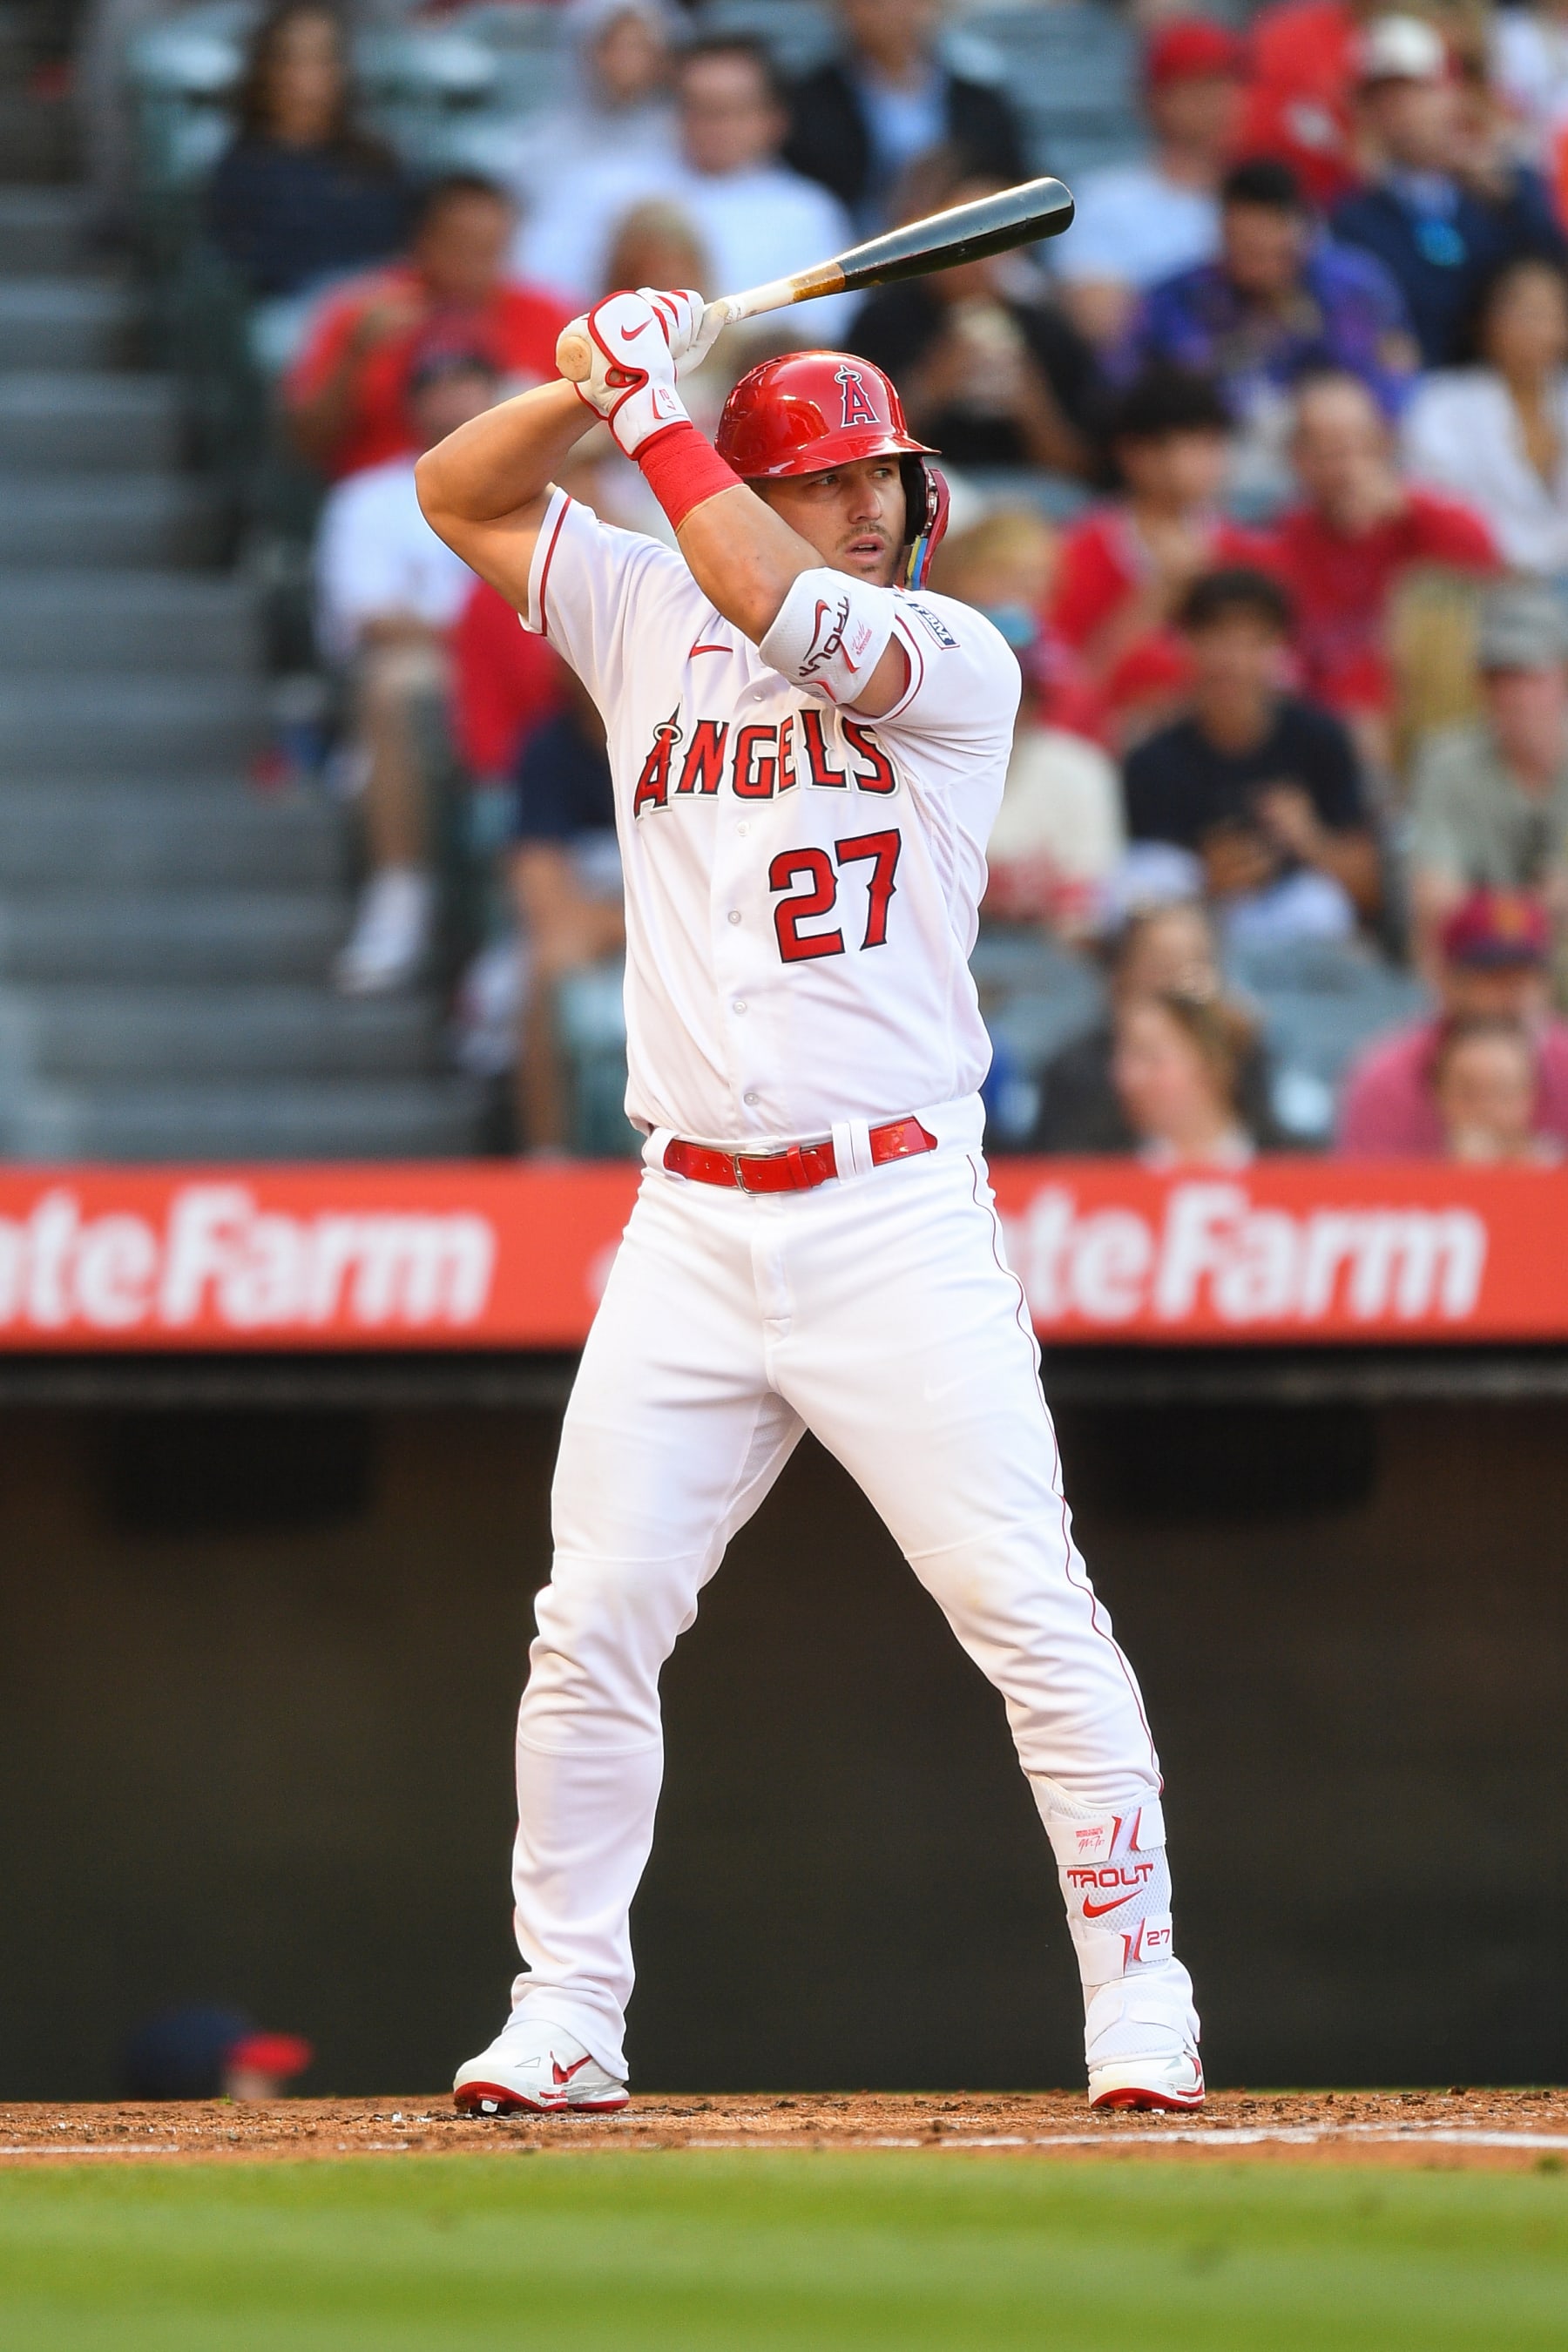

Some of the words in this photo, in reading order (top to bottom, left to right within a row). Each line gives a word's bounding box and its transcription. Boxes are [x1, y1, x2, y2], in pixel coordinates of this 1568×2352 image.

[659, 389, 676, 411] 27
[834, 364, 881, 428] A
[799, 596, 851, 677] TROUT
[910, 604, 955, 642] FBM
[633, 700, 900, 821] ANGELS
[767, 828, 902, 964] 27
[1067, 1862, 1154, 1889] TROUT
[1146, 1929, 1171, 1946] 27
